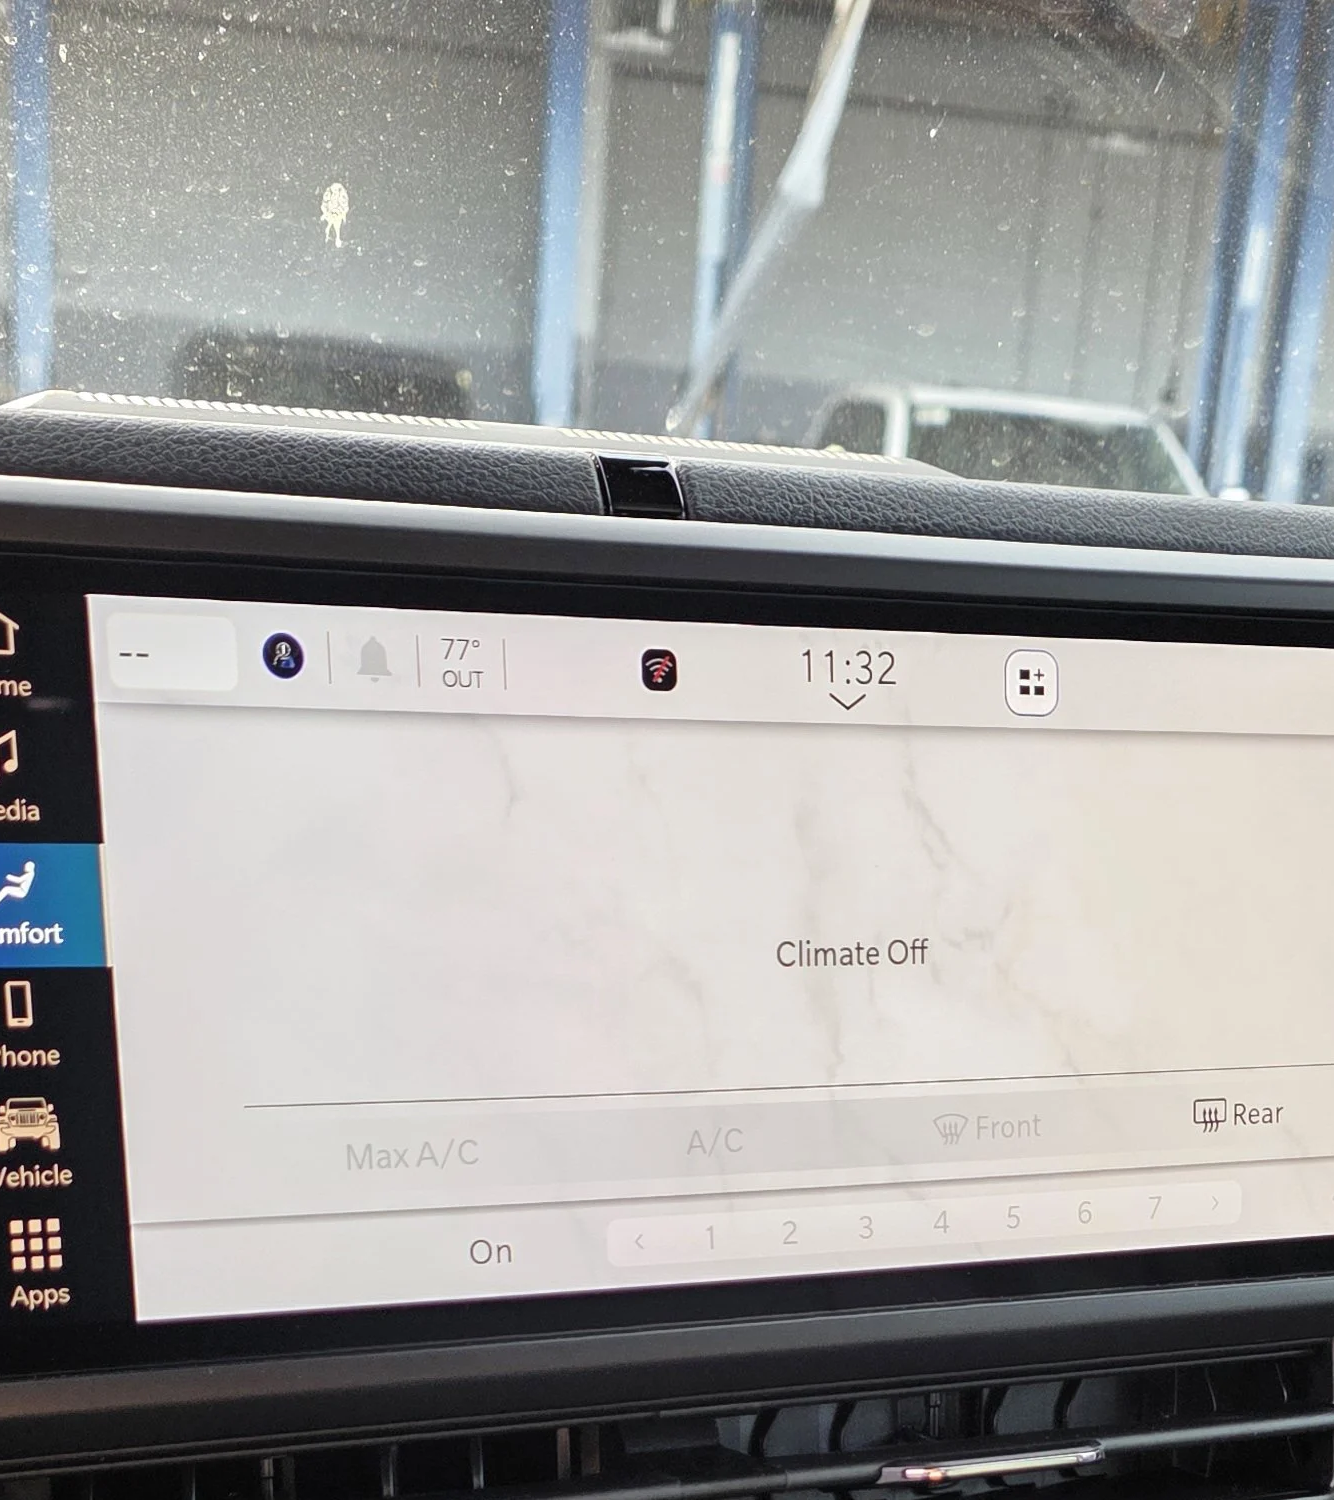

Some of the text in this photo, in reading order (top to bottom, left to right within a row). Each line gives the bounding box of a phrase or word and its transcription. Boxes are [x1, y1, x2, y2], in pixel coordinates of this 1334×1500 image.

[440, 638, 480, 661] 77°
[442, 669, 484, 689] OUT
[802, 649, 897, 685] 11:32
[776, 937, 929, 968] Climate Off
[976, 1113, 1042, 1141] Front
[1233, 1103, 1284, 1126] Rear
[346, 1138, 479, 1171] Max A/C
[686, 1127, 743, 1157] A/C
[706, 1195, 1162, 1250] 1 2 3 4 5 6 7
[469, 1239, 512, 1265] On
[10, 1285, 71, 1311] Apps
